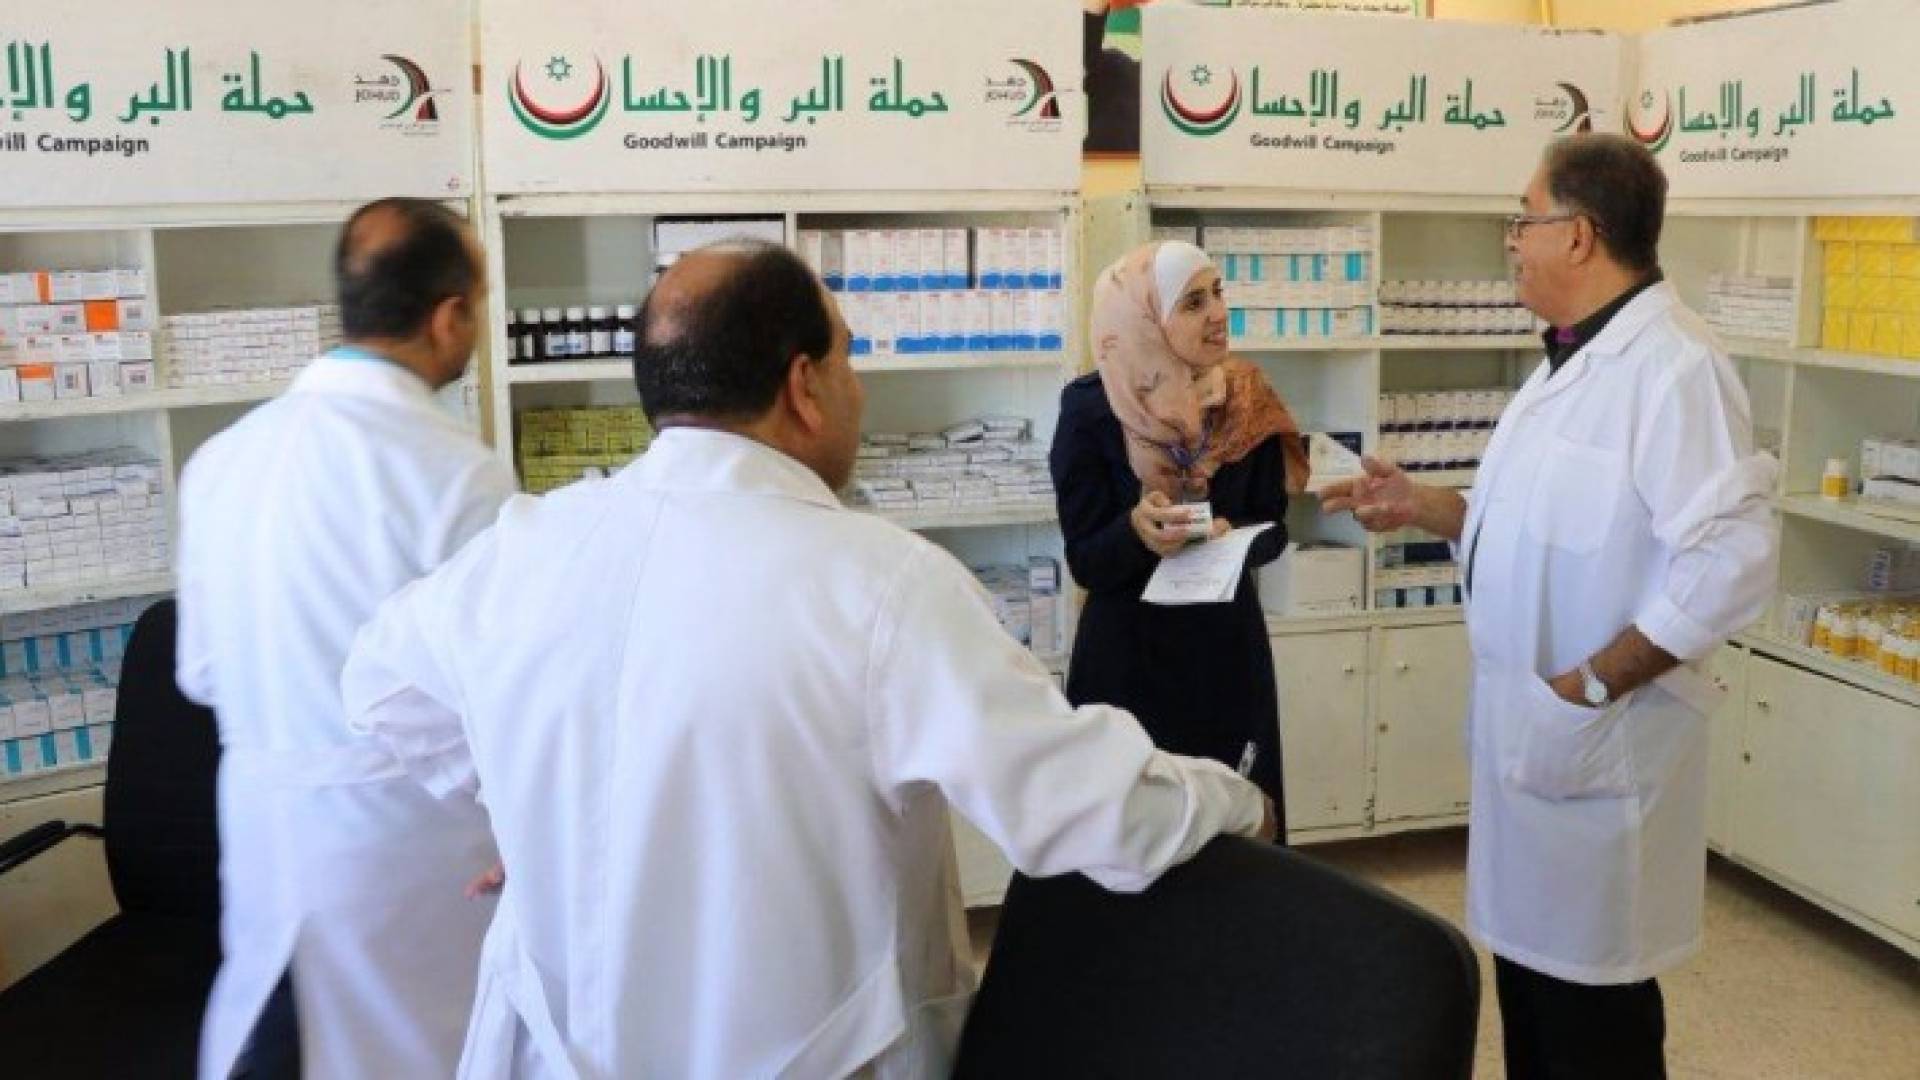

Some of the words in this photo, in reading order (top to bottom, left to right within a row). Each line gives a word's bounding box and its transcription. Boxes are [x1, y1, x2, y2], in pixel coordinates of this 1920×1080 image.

[119, 46, 192, 125] البر
[221, 49, 314, 119] حملة
[783, 54, 843, 124] البر
[869, 55, 949, 119] حملة
[1377, 73, 1427, 132] البر
[1444, 77, 1506, 130] حملة
[1773, 72, 1816, 138] البر
[1832, 66, 1895, 125] حملة
[37, 134, 150, 157] Campaign
[623, 132, 708, 149] Goodwill
[715, 132, 807, 152] Campaign
[1250, 132, 1318, 150] Goodwill
[1323, 134, 1395, 155] Campaign
[1680, 147, 1727, 163] Goodwill
[1730, 145, 1789, 163] Campaign
